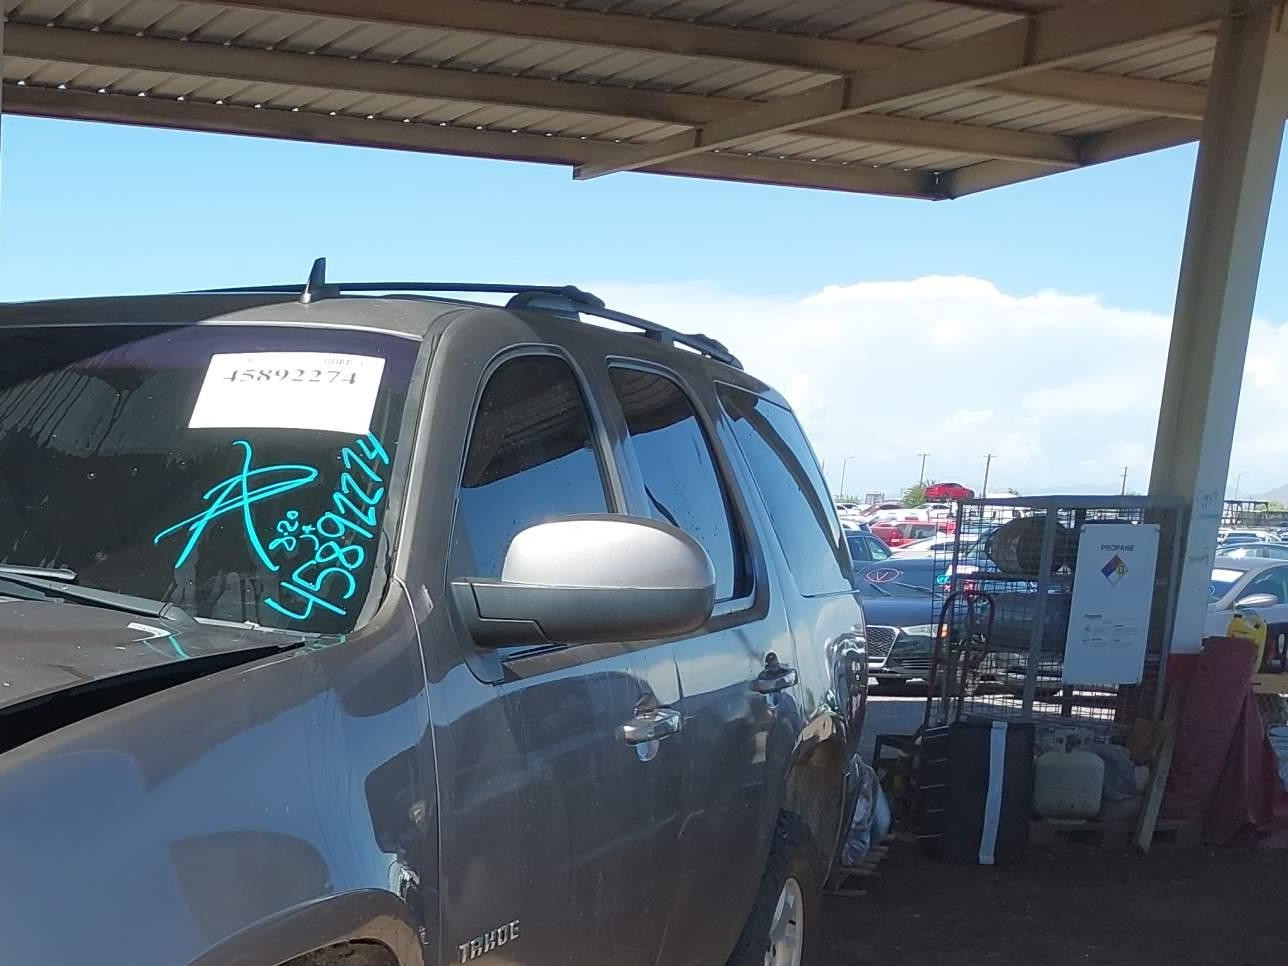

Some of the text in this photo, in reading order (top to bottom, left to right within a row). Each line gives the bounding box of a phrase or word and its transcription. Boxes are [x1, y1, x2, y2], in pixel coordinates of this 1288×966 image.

[223, 368, 357, 385] 45892274
[263, 430, 390, 621] 45892274
[1100, 544, 1135, 552] PROPANE
